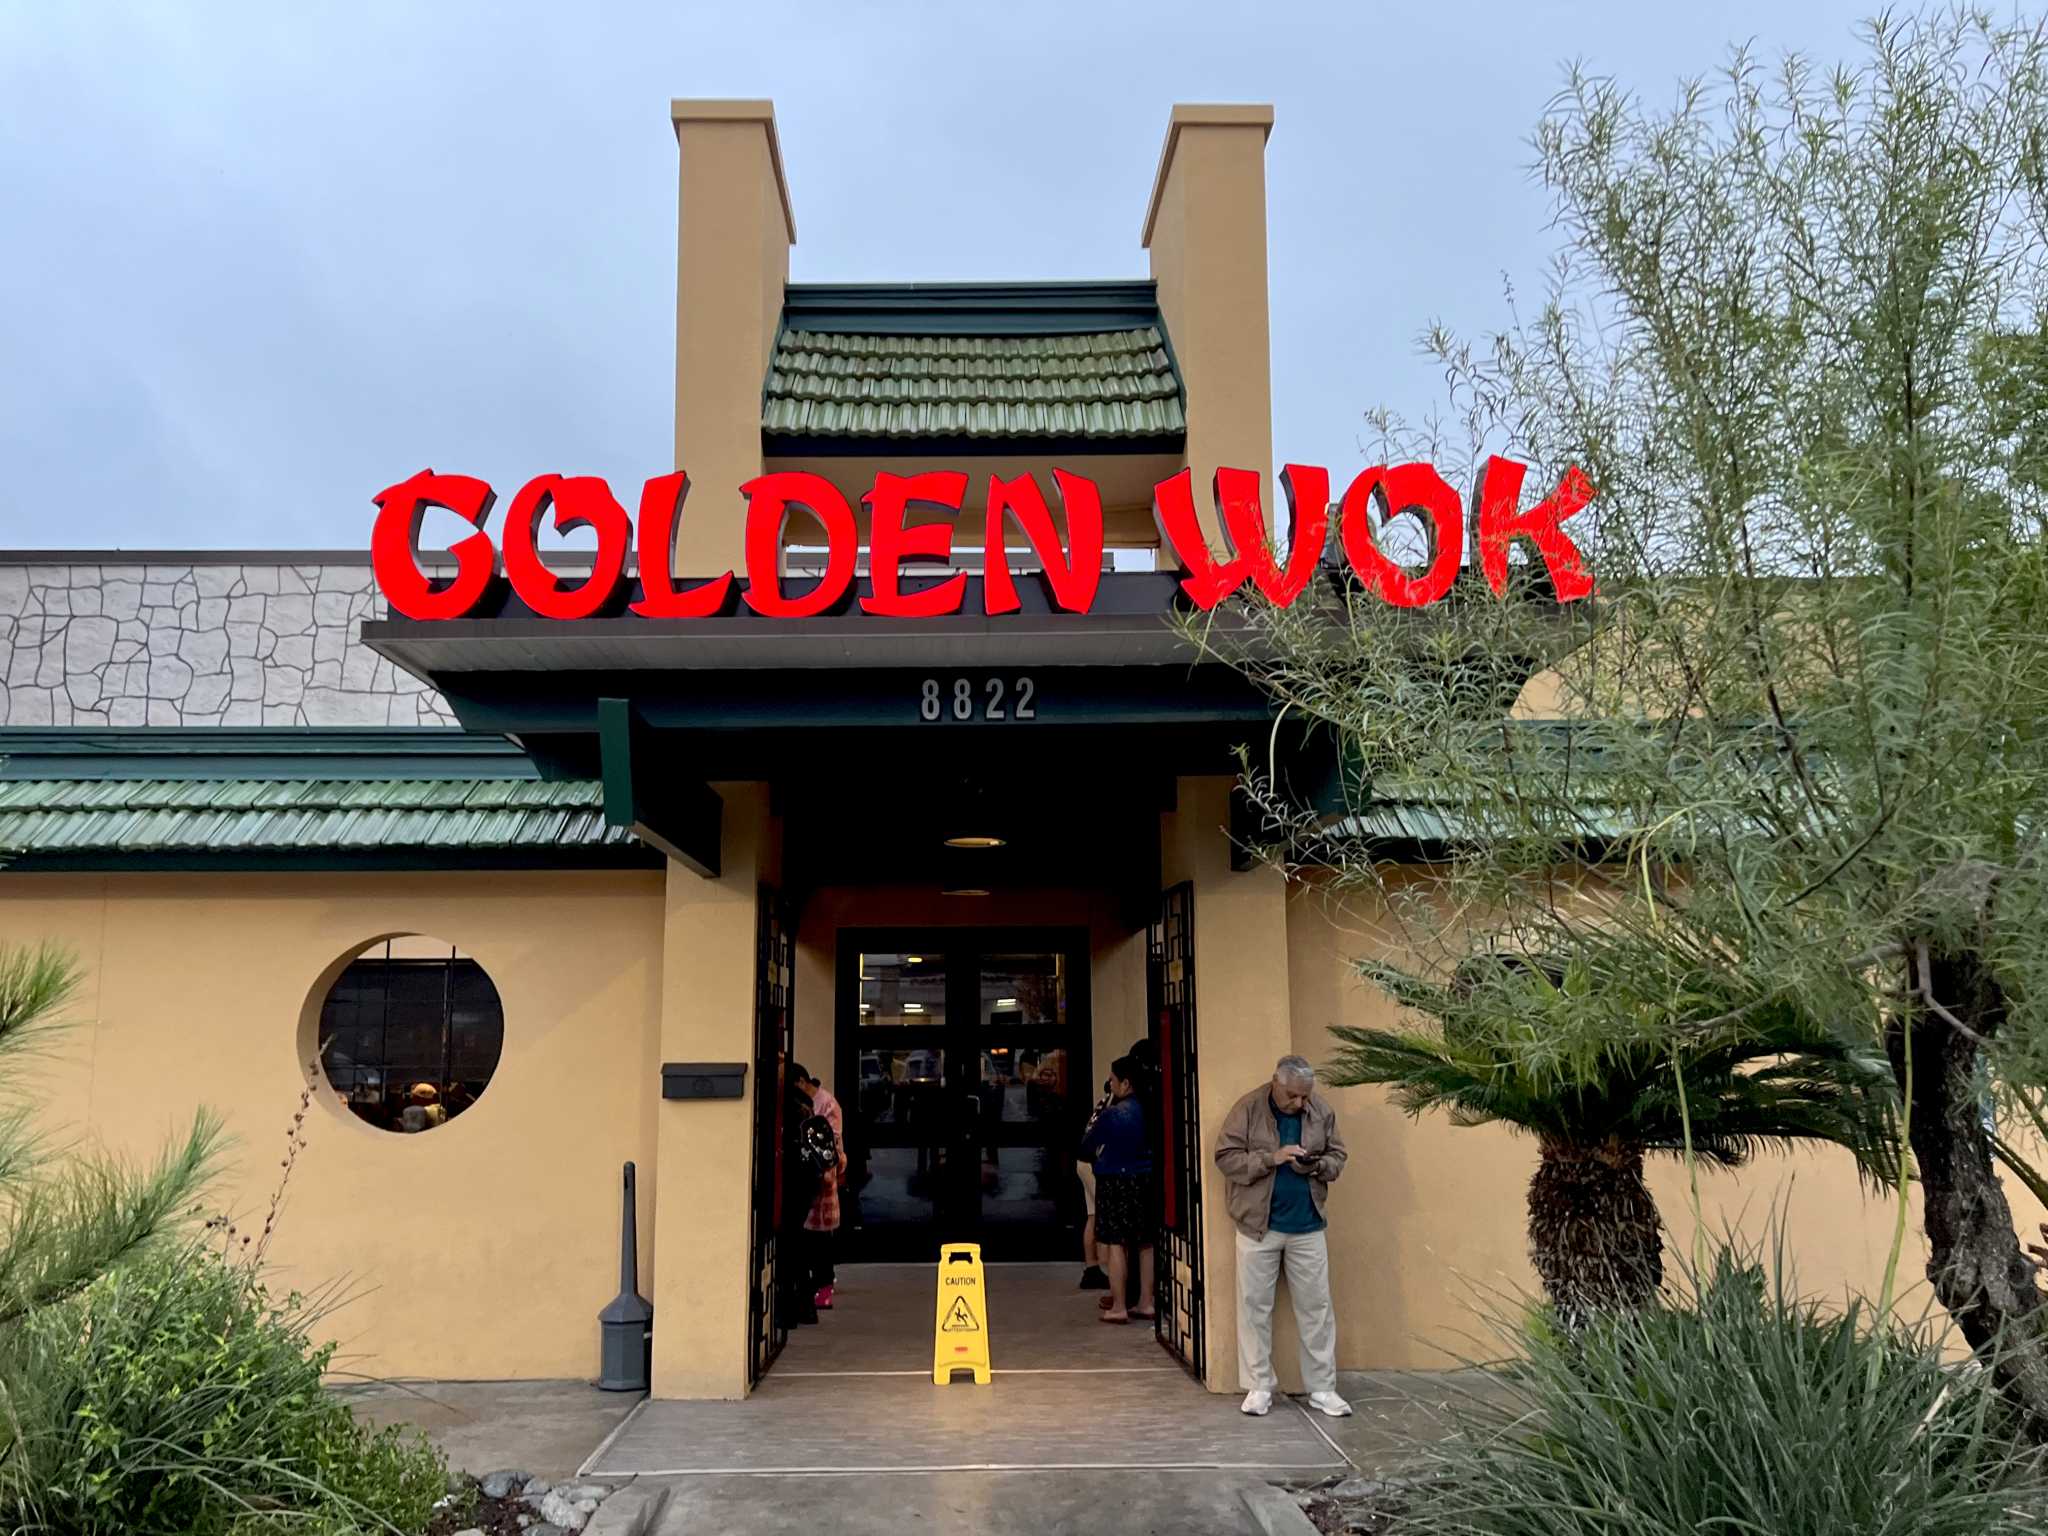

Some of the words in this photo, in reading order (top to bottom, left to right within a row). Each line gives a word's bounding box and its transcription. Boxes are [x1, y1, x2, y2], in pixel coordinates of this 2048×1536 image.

[371, 468, 1104, 620] GOLDEN
[1153, 454, 1598, 611] WOK
[921, 677, 1035, 720] 8822
[945, 1277, 976, 1286] CAUTION
